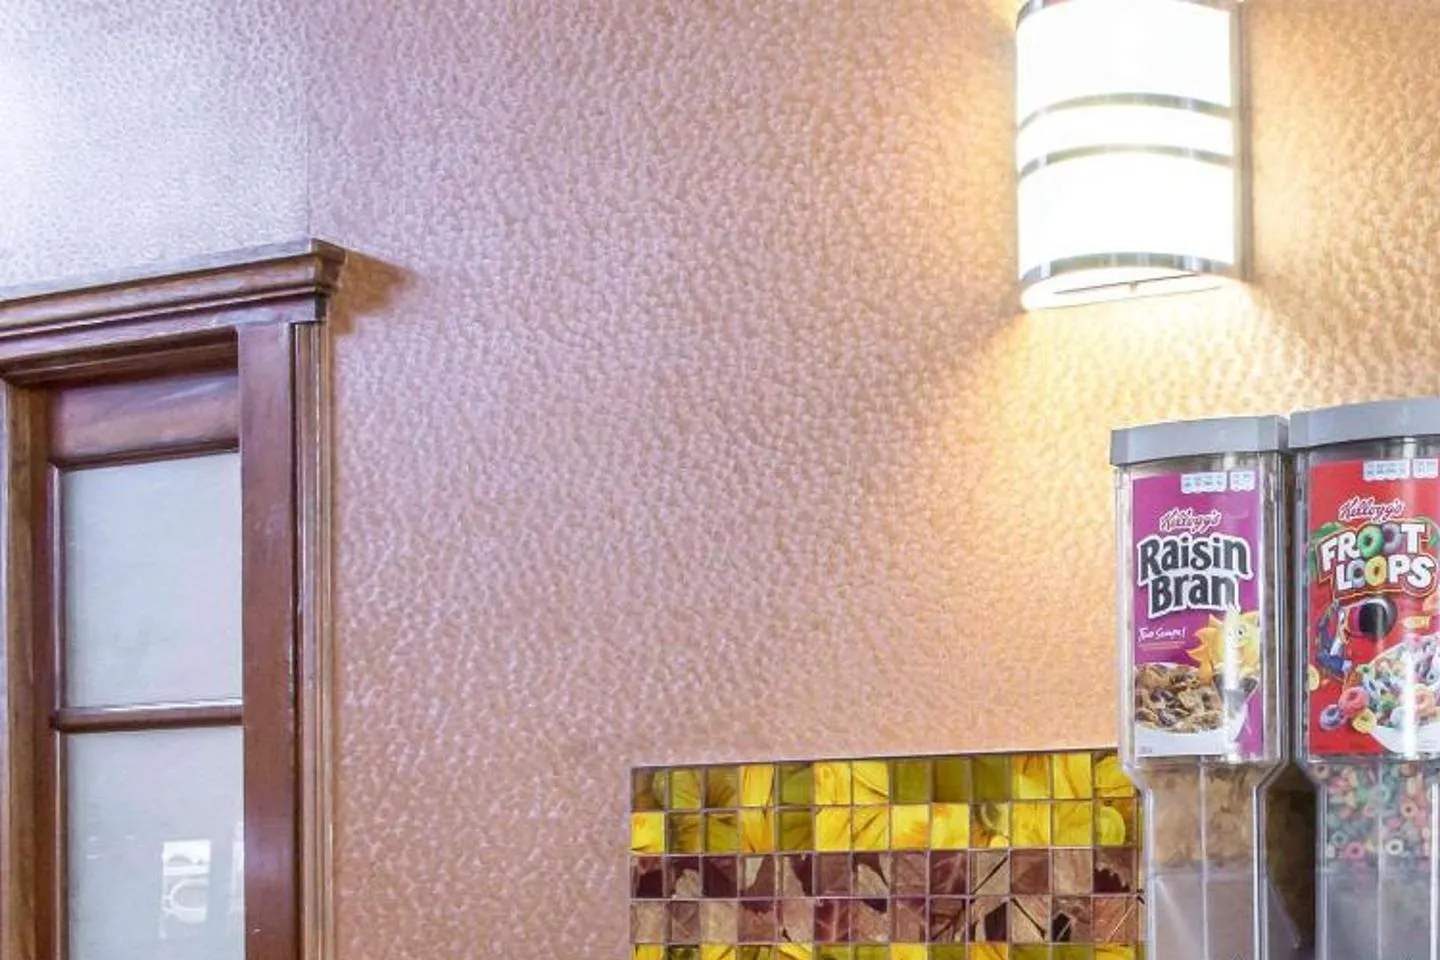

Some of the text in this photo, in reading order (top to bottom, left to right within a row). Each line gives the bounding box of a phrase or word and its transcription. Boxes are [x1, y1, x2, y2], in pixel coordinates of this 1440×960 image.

[1160, 507, 1222, 533] Kellogg's
[1337, 496, 1406, 524] Kellogg's
[1138, 535, 1250, 582] Raisin
[1320, 522, 1426, 573] FROOT
[1335, 553, 1437, 591] LOOPS
[1150, 573, 1237, 615] Bran
